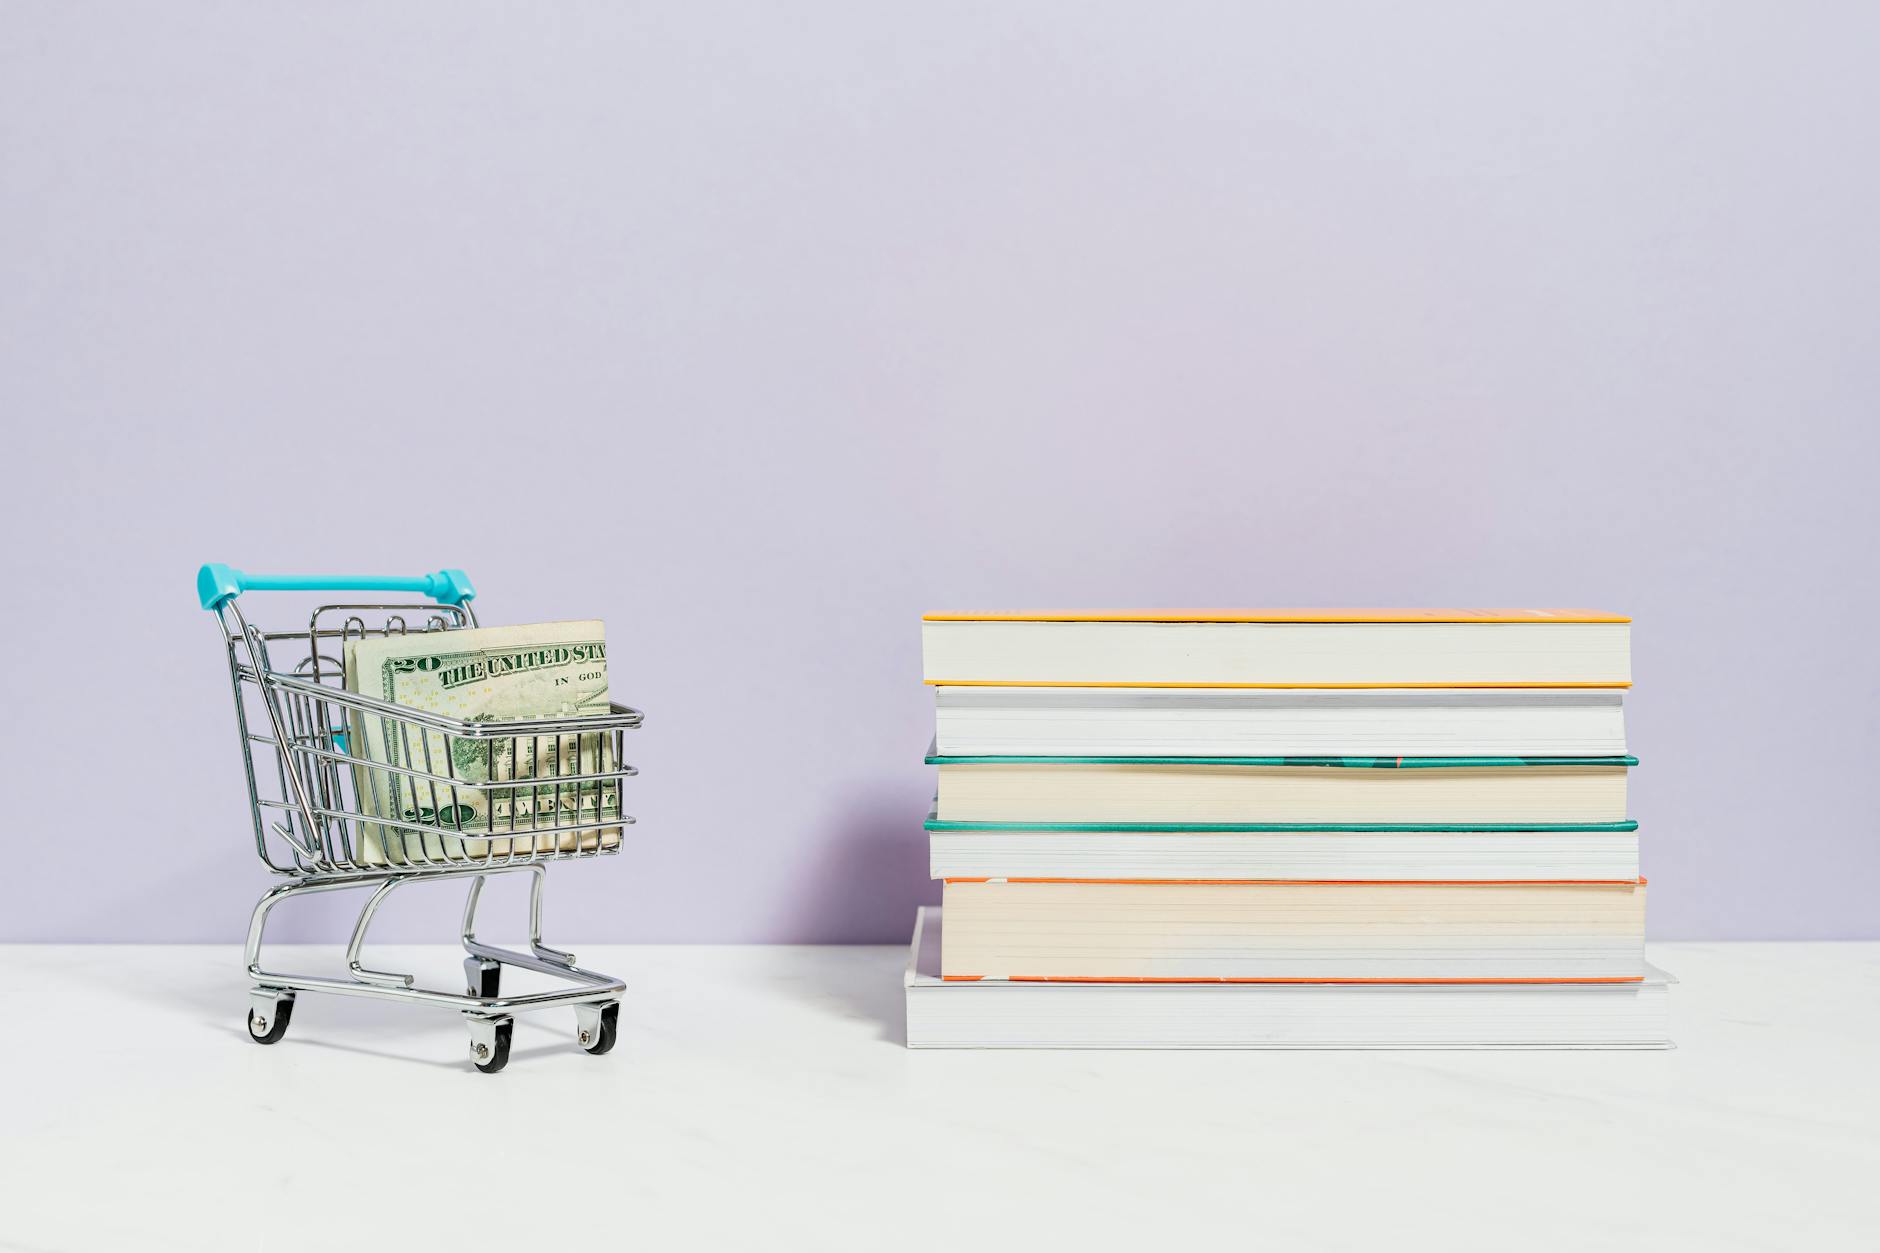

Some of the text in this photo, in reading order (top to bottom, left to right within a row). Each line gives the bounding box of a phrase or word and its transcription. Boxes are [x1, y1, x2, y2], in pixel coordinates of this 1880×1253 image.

[393, 656, 443, 675] 20
[438, 644, 606, 690] THE UNITED STA
[554, 671, 602, 687] IN GOD
